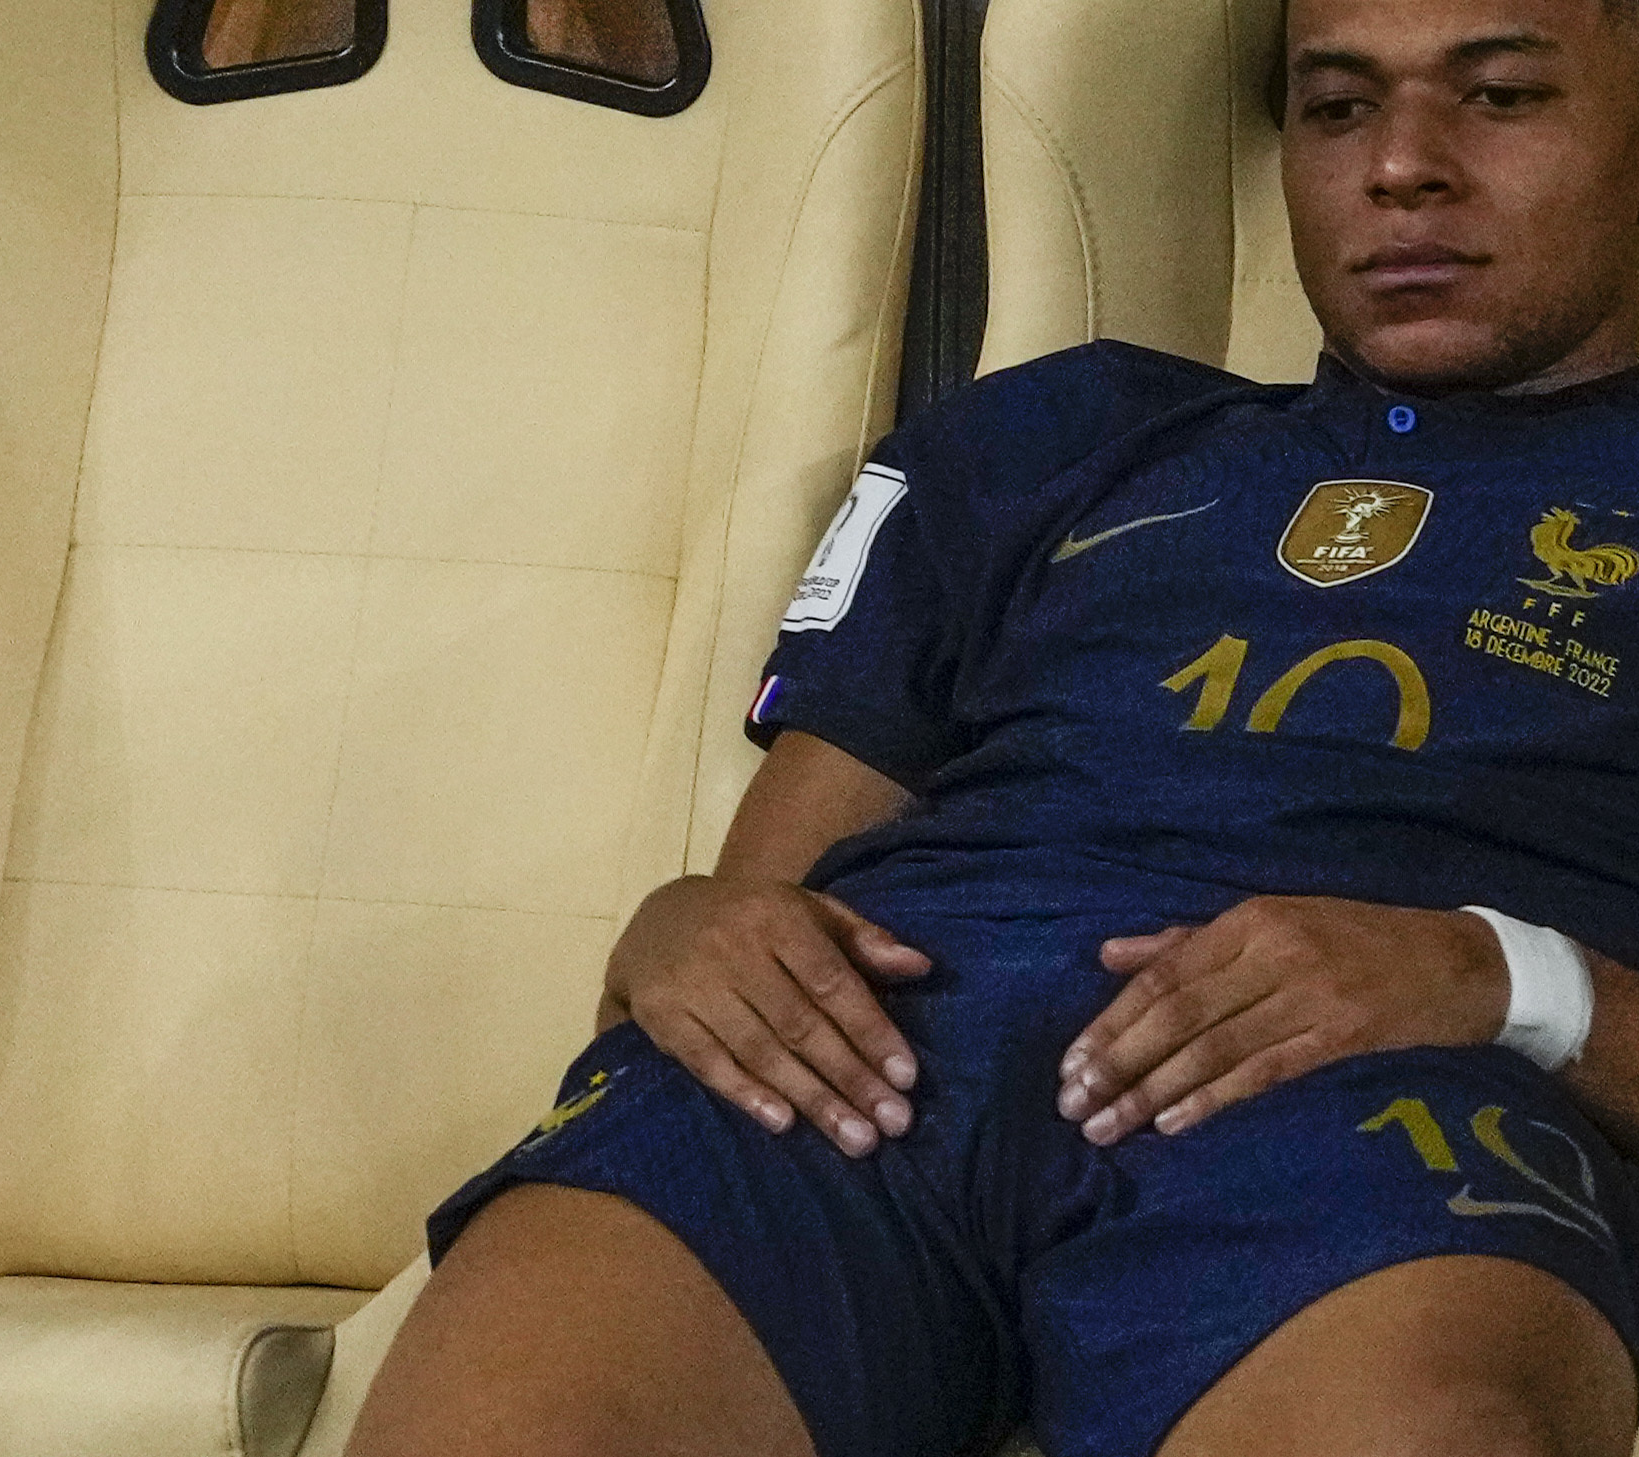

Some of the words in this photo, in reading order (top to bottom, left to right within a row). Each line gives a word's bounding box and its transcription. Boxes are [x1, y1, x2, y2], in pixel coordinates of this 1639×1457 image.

[1312, 545, 1367, 560] FIFA
[1464, 627, 1483, 649] 18
[1567, 662, 1612, 698] 2022
[1467, 607, 1553, 648] ARGENTINE
[1564, 638, 1621, 678] FRANCE
